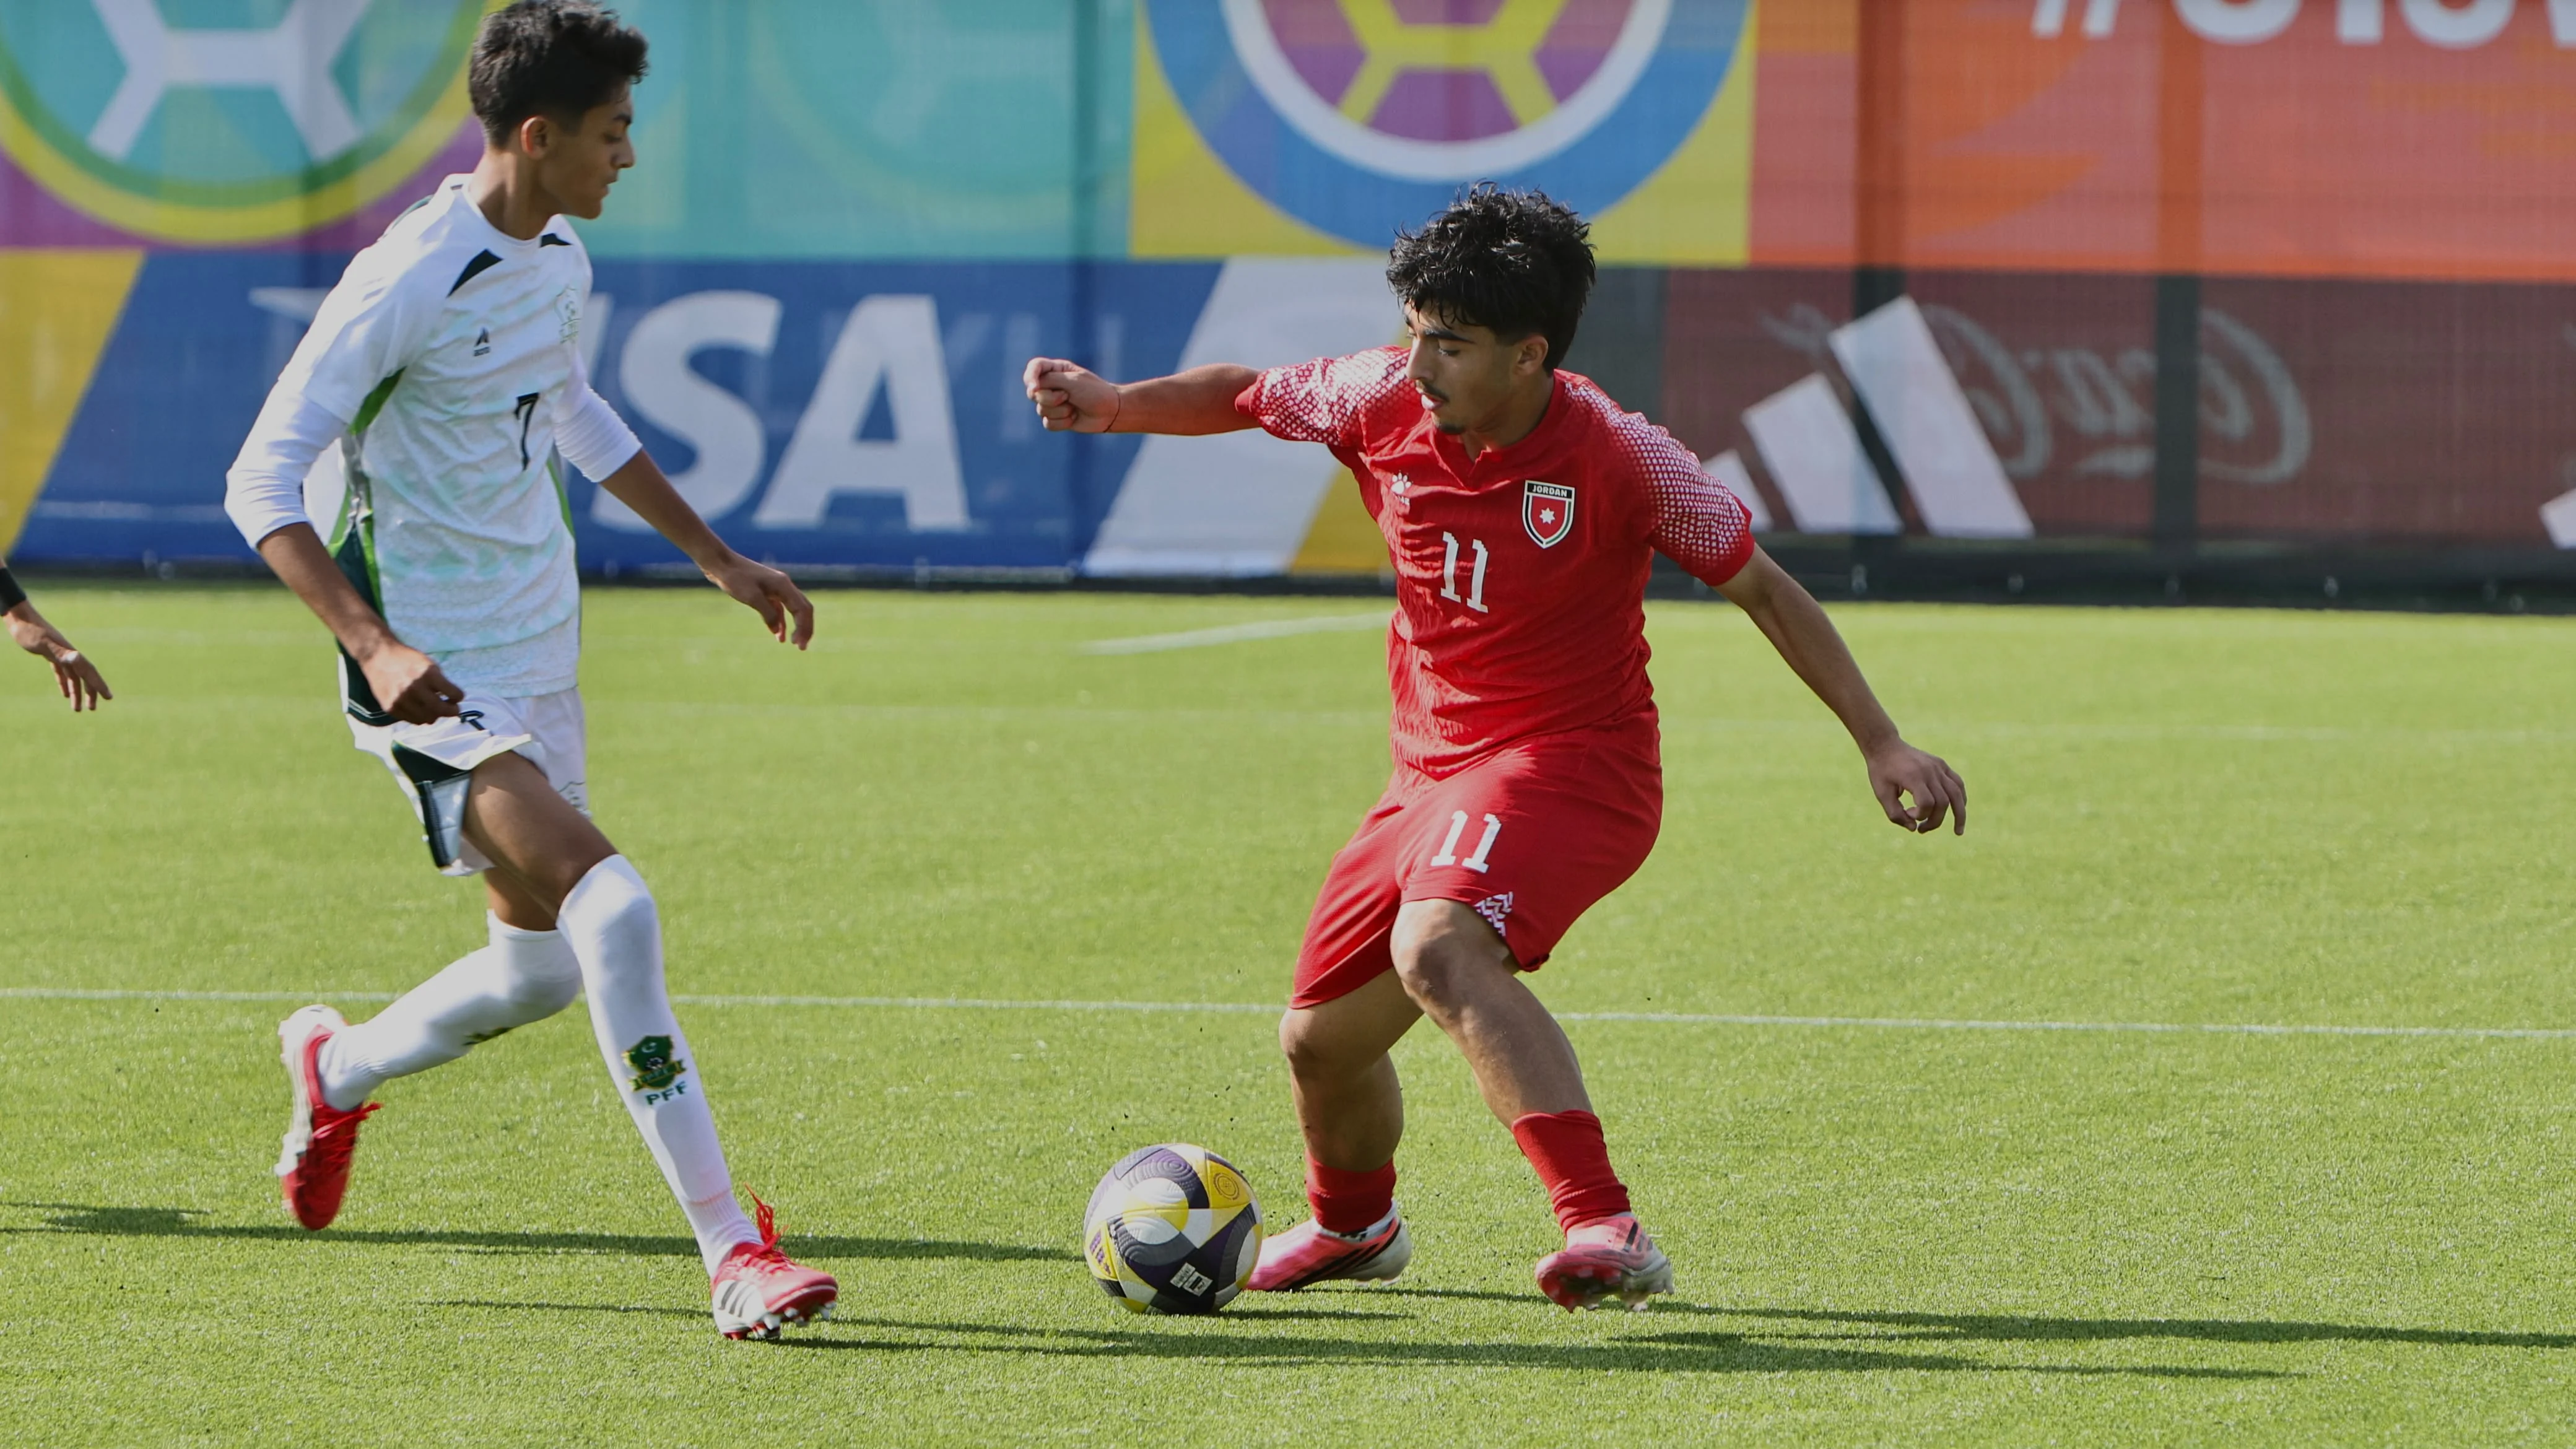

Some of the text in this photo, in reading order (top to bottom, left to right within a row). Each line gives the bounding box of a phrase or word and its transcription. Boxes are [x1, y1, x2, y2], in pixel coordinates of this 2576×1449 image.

[250, 287, 970, 534] SA
[514, 391, 540, 471] 7
[1533, 485, 1567, 497] JORDAN
[1440, 531, 1489, 614] 11
[1430, 810, 1502, 873] 11
[645, 1081, 687, 1105] PFF
